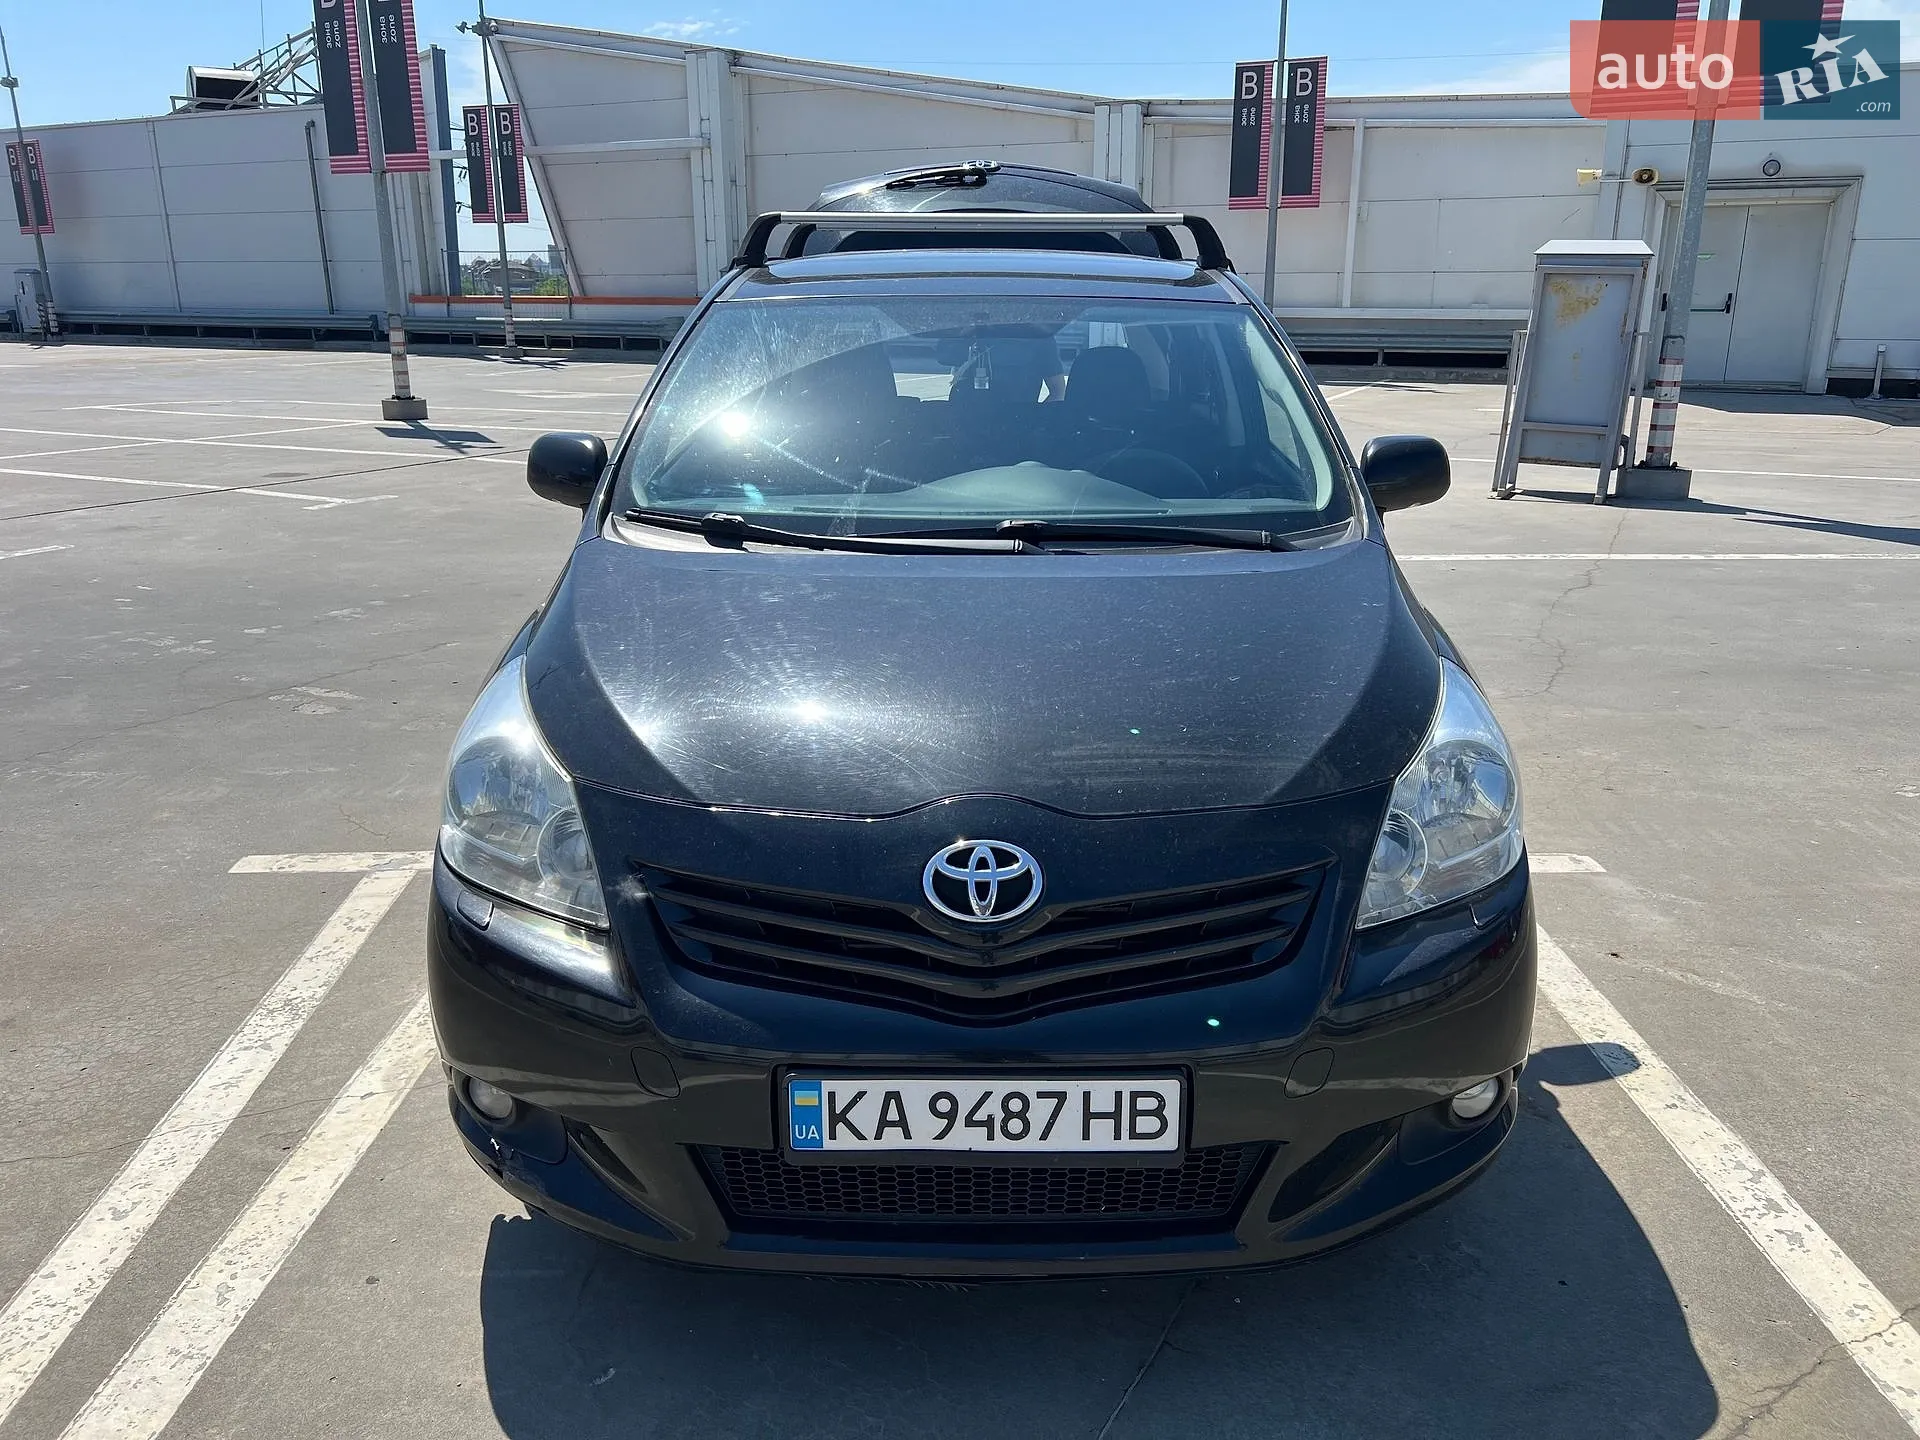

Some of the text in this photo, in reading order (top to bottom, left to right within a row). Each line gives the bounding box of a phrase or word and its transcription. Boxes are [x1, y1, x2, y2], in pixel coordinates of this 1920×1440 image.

[324, 21, 333, 49] зона
[332, 20, 341, 48] zone
[379, 16, 388, 44] зона
[388, 14, 398, 43] zone
[1241, 71, 1258, 100] B
[1295, 67, 1313, 97] B
[467, 113, 479, 136] B
[500, 112, 512, 135] B
[827, 1090, 1169, 1142] KA 9487 HB
[795, 1124, 820, 1141] UA
